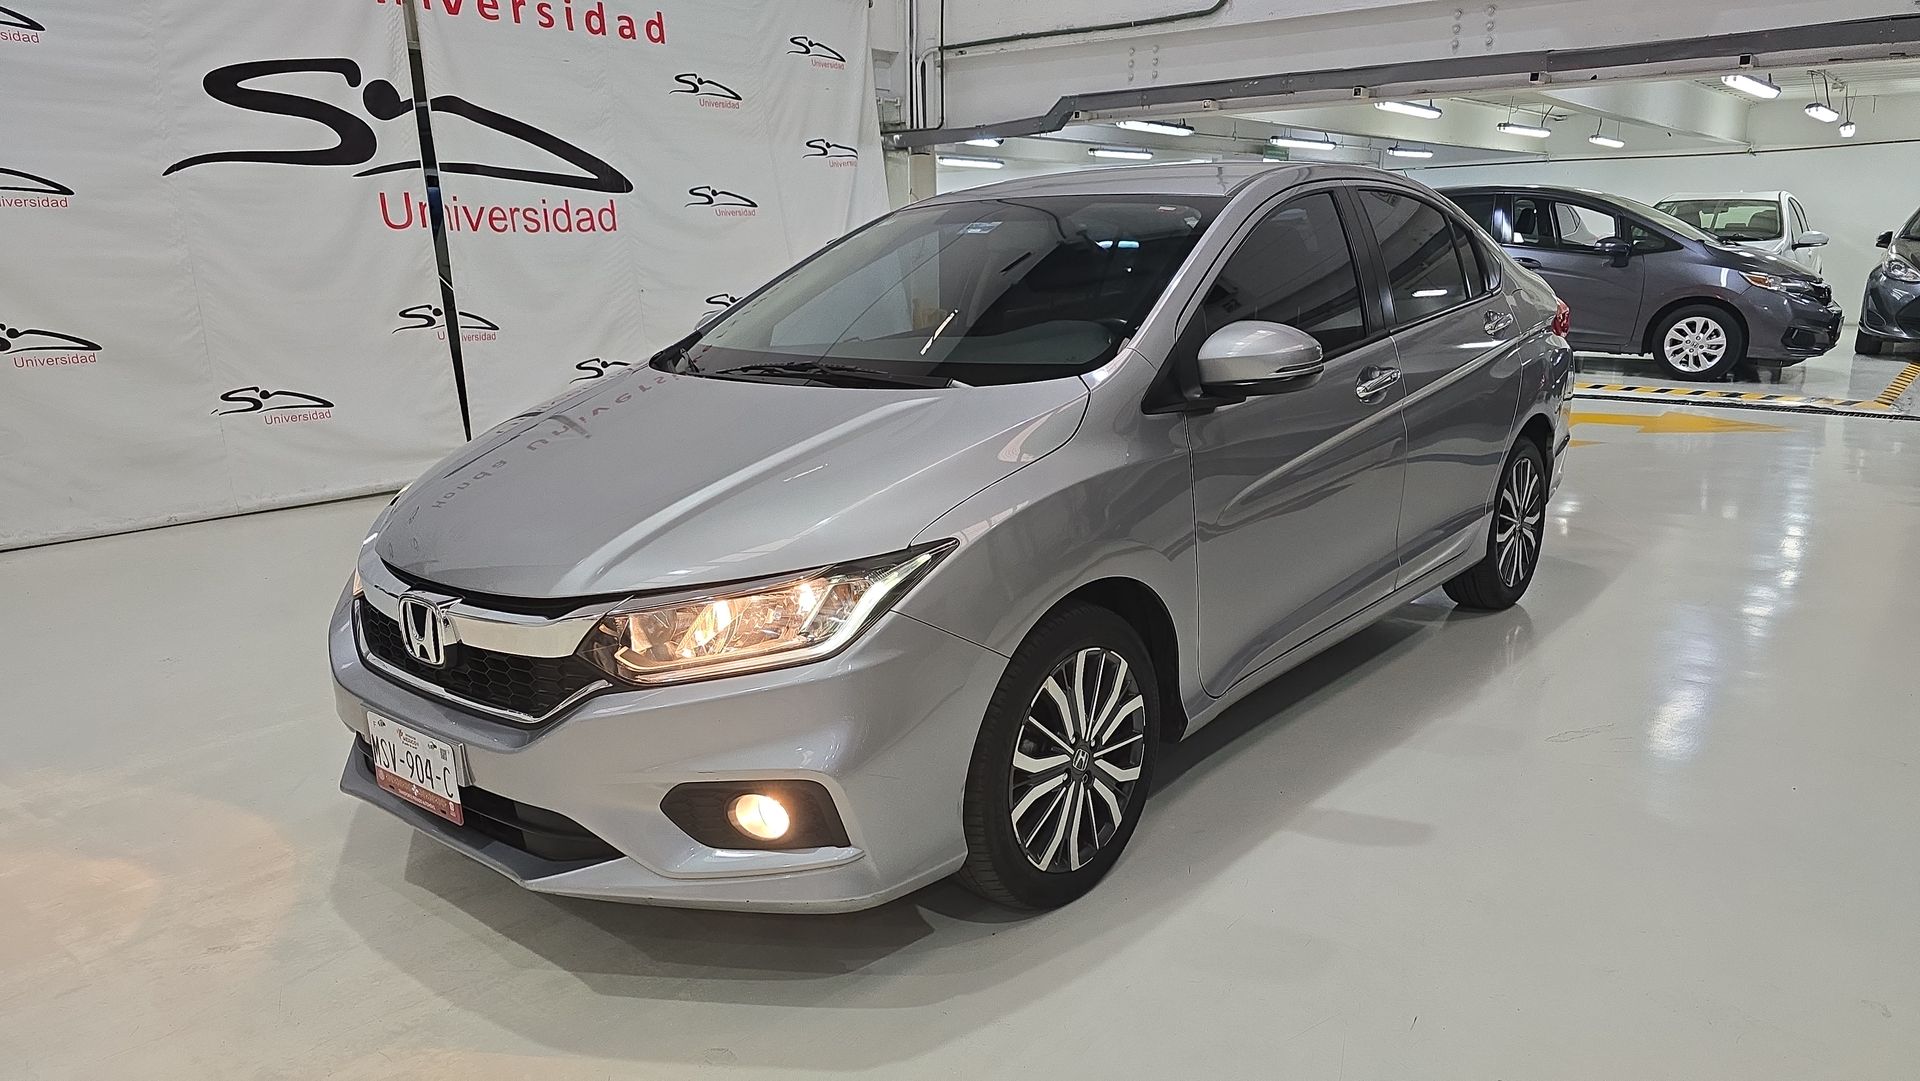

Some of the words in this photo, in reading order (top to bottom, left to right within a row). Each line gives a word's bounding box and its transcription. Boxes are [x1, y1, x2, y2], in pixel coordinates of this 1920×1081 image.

[811, 59, 845, 70] Universidad
[699, 99, 740, 109] Universidad
[715, 208, 756, 217] Universidad
[437, 331, 497, 342] Uiversidad
[13, 352, 97, 369] Universidad
[264, 409, 332, 425] Universidad
[370, 734, 454, 798] MSV-904-C
